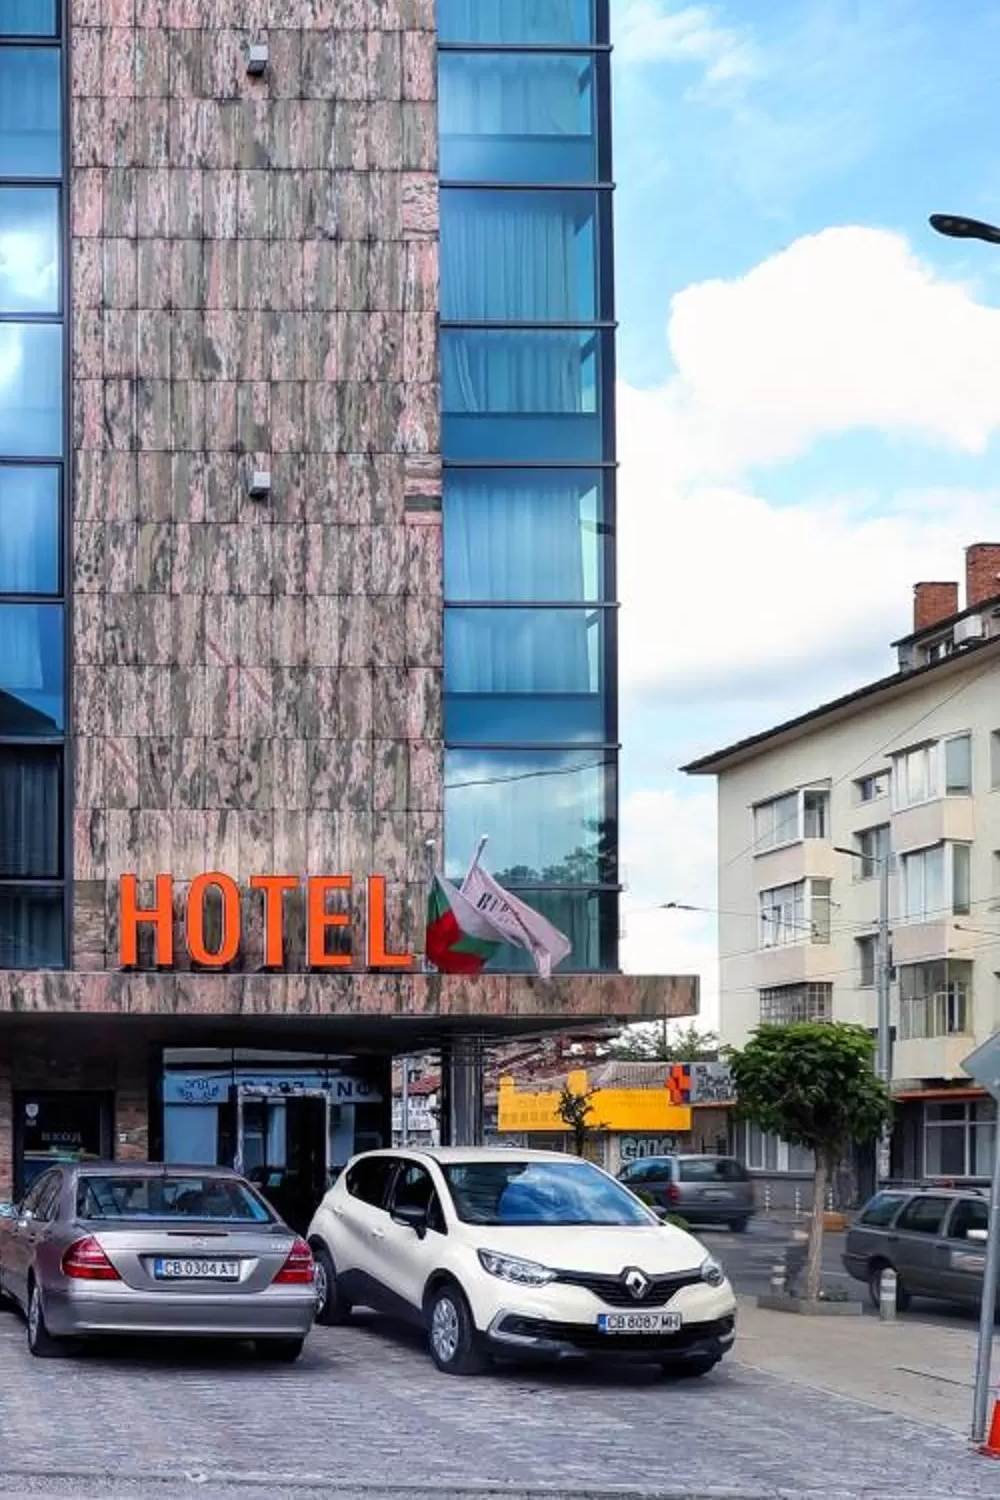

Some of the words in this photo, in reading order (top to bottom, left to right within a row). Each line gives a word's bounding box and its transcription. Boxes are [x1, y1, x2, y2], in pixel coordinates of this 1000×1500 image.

[119, 871, 413, 967] HOTEL
[185, 1262, 216, 1275] 0304
[220, 1263, 236, 1275] AT
[627, 1315, 658, 1329] 8087
